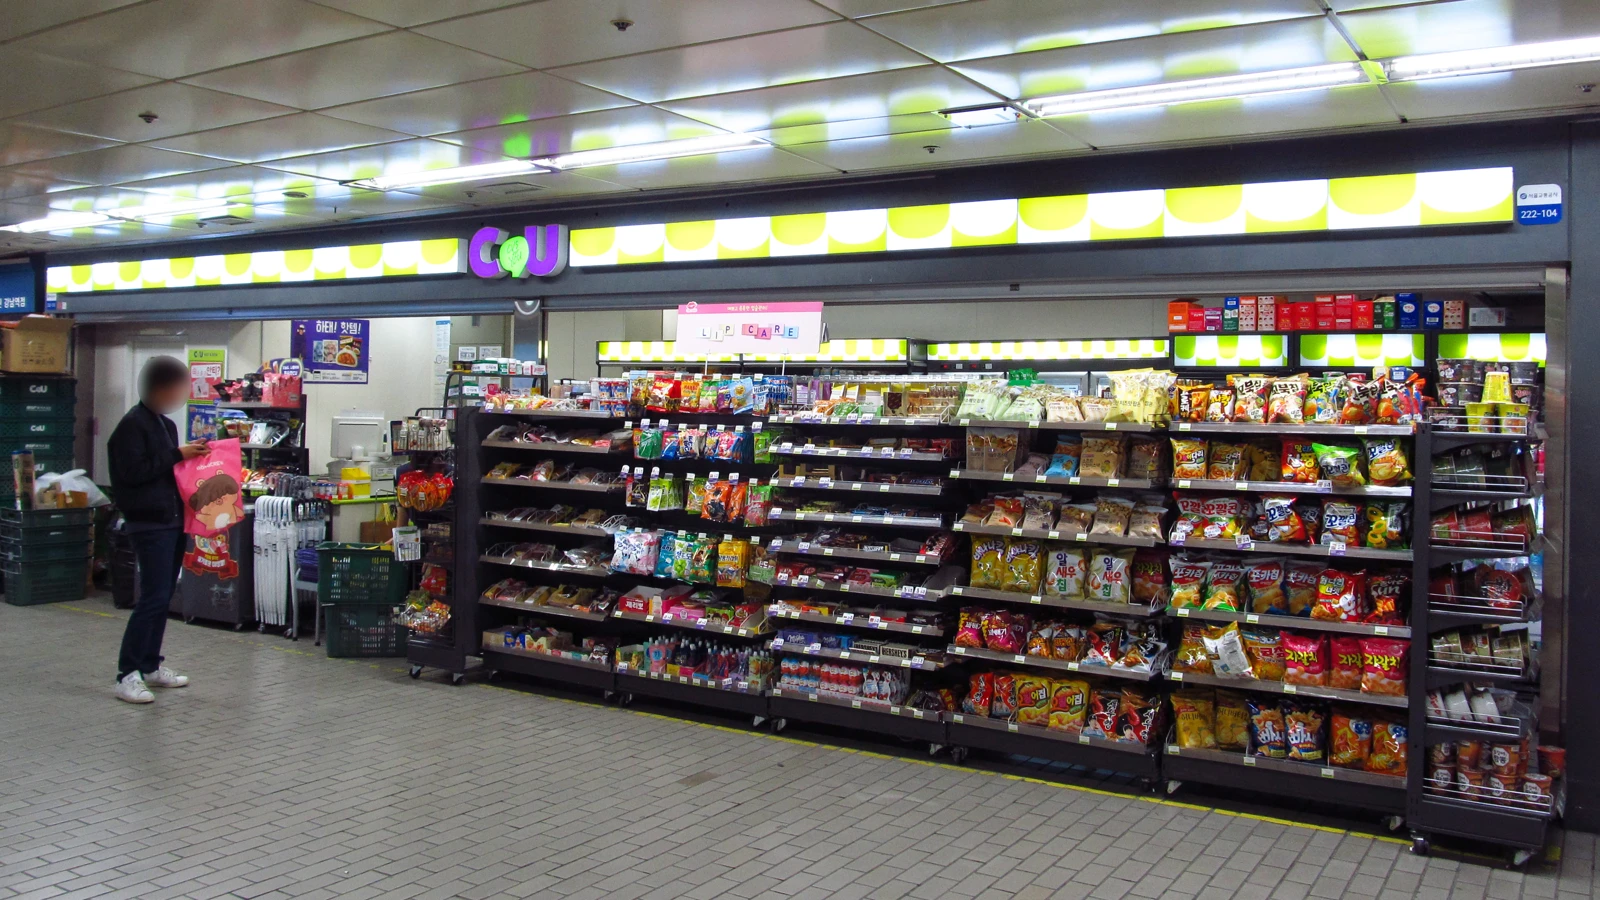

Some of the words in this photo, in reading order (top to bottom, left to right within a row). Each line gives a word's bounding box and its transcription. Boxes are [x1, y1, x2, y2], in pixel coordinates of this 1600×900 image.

[1520, 208, 1558, 220] 222-104
[469, 224, 568, 279] CU
[316, 320, 338, 333] 하태!
[341, 322, 361, 334] 핫템!
[702, 325, 731, 340] LIP
[748, 325, 794, 338] CARE
[1272, 382, 1300, 396] 꼬북칩
[1202, 502, 1239, 516] 꼬깔콘
[1324, 512, 1356, 528] 꼬깔콘
[1056, 553, 1069, 567] 알
[1056, 569, 1077, 581] 새우
[1103, 572, 1123, 585] 새우
[1174, 567, 1205, 578] 포카칩
[1250, 567, 1280, 581] 포카칩
[1056, 580, 1067, 593] 칩
[1102, 583, 1113, 597] 칩
[881, 646, 908, 659] HERSHEY'S
[1285, 650, 1317, 667] 자갈치
[1364, 653, 1401, 671] 자갈치
